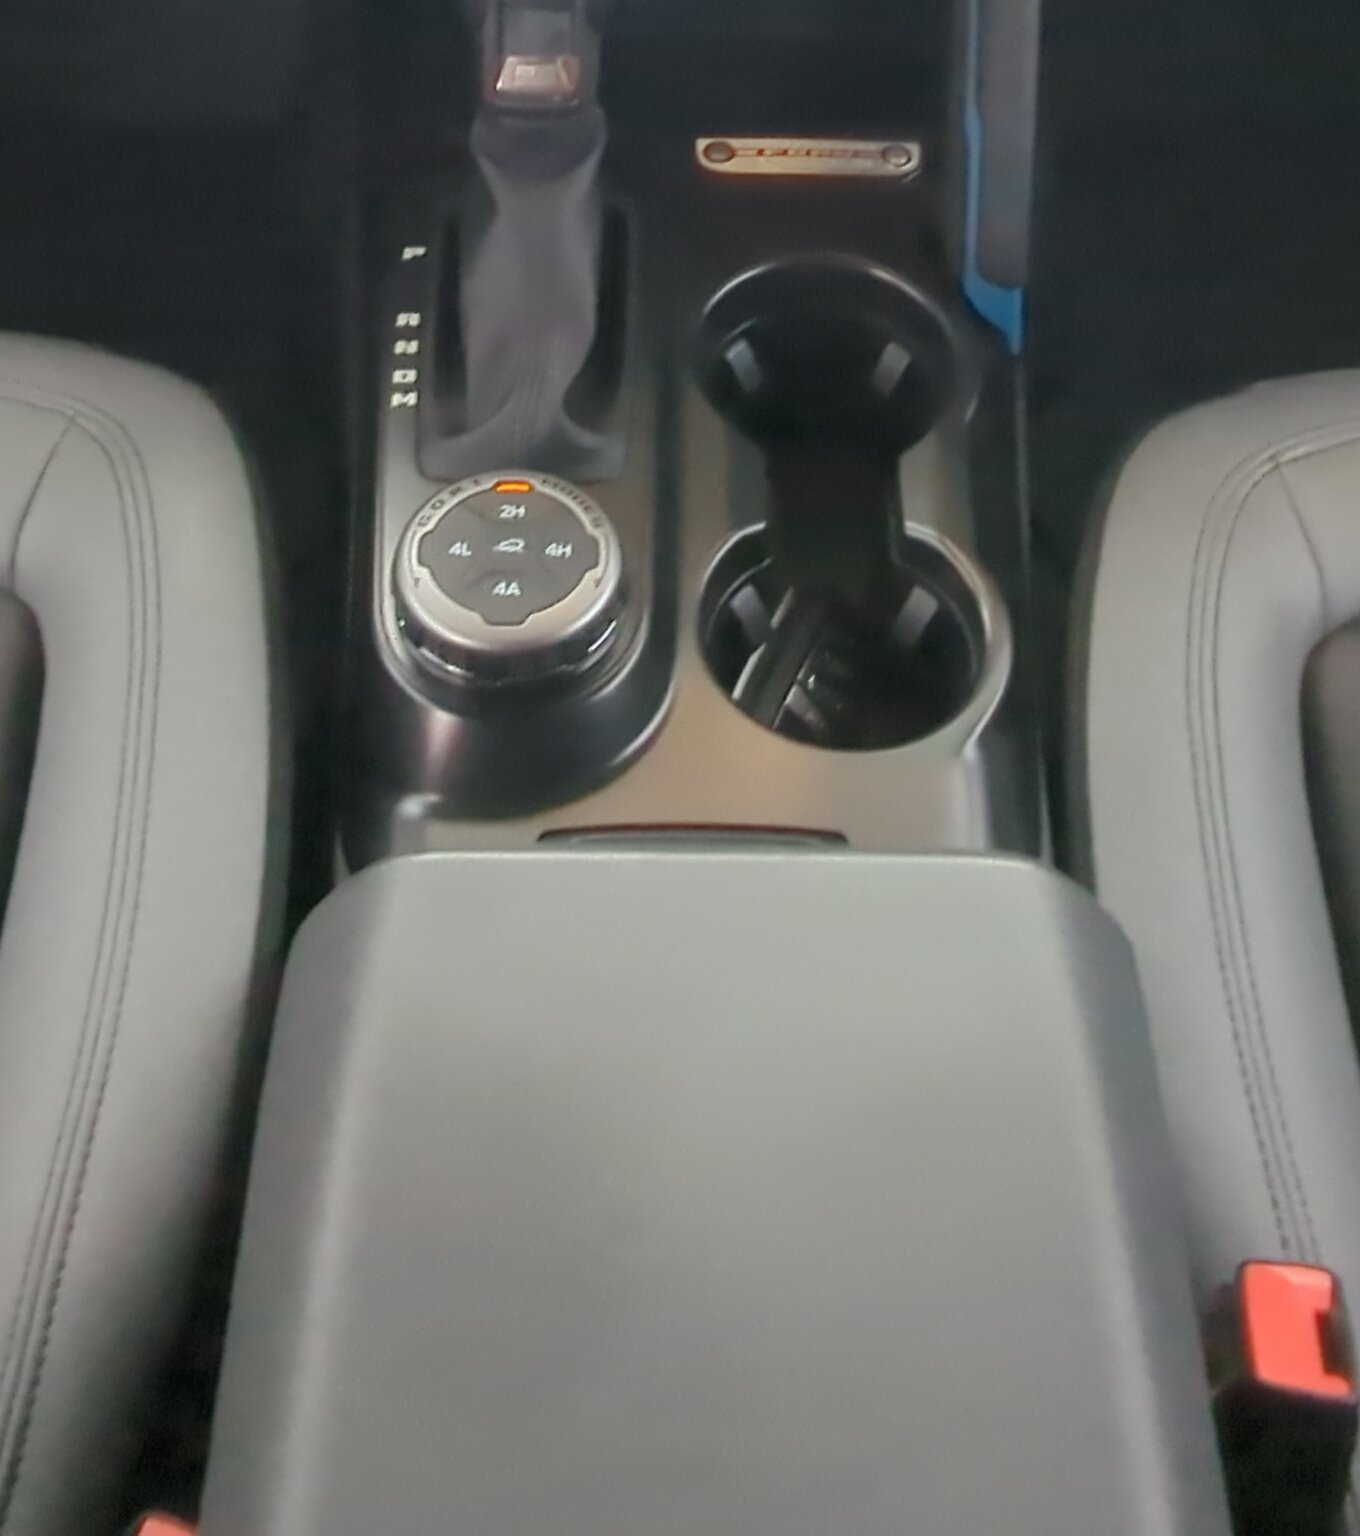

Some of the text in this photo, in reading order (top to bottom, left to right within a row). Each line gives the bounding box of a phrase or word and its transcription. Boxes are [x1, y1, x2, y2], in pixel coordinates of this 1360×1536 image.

[391, 391, 418, 407] M
[499, 504, 525, 519] 2H
[448, 542, 472, 557] 4L
[545, 543, 572, 558] 4H
[493, 582, 521, 595] 4A
